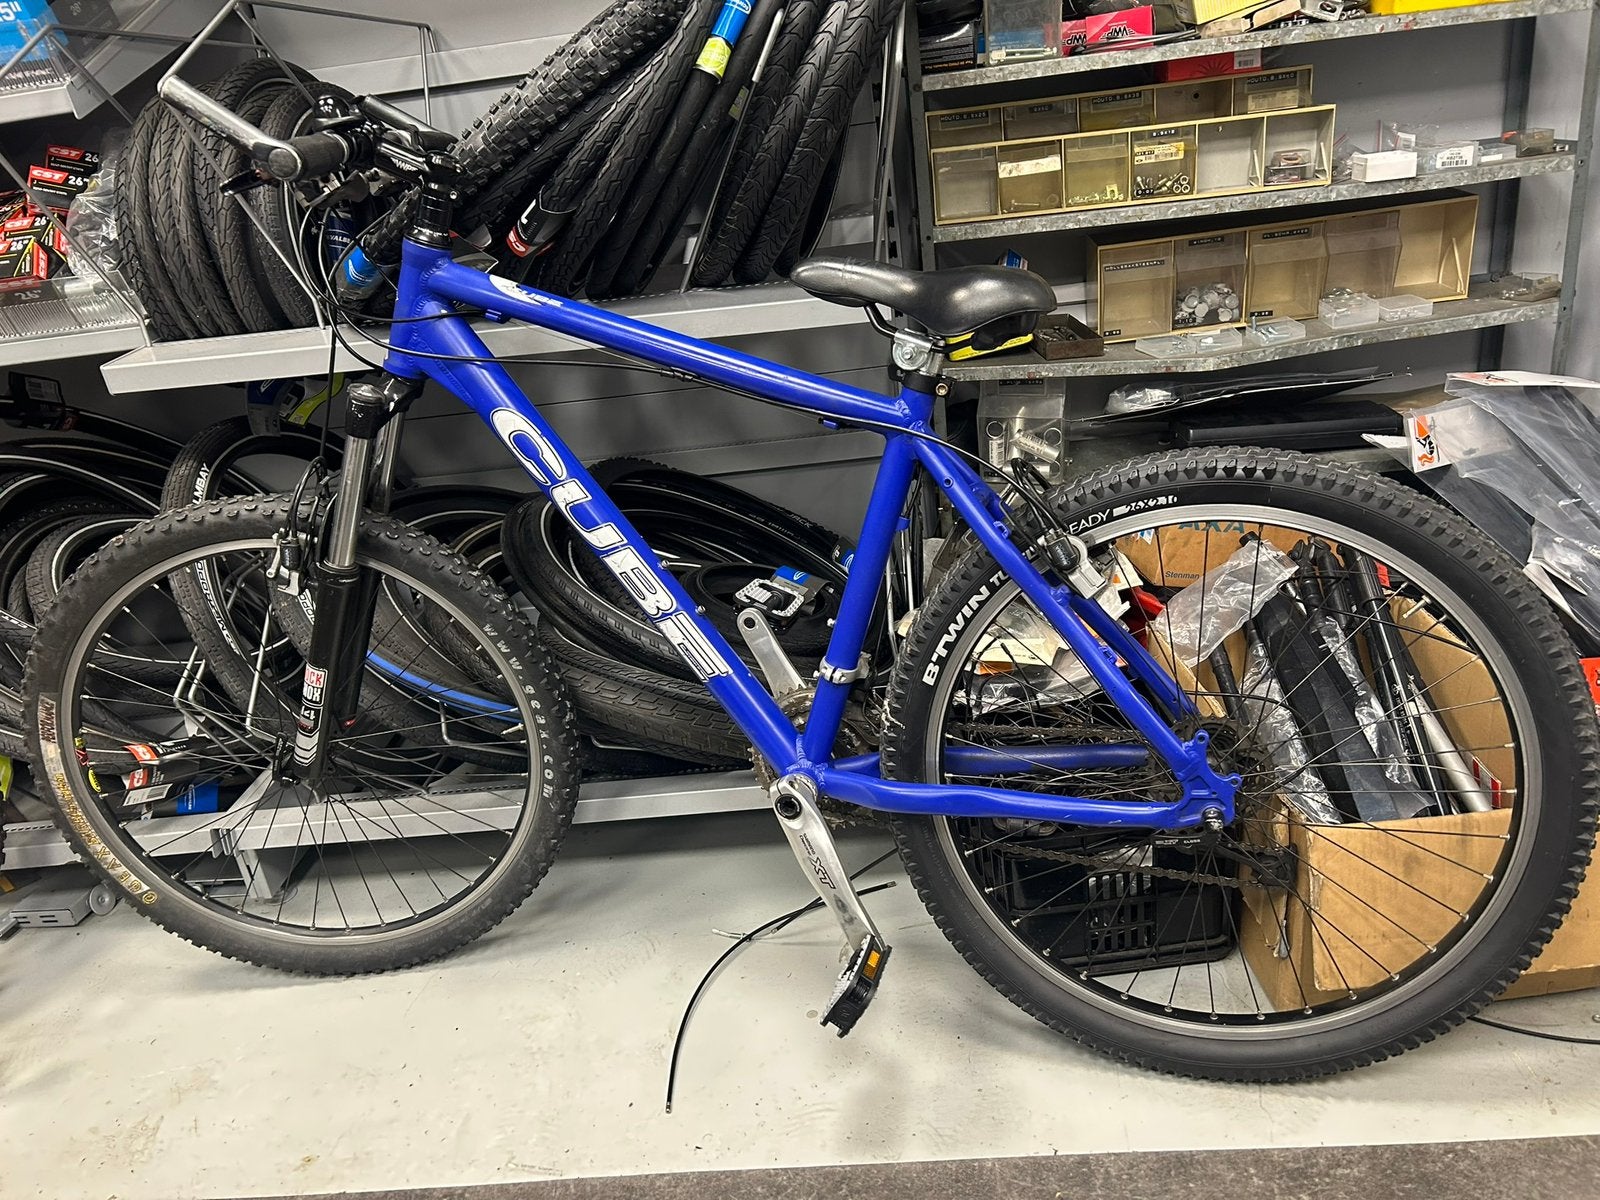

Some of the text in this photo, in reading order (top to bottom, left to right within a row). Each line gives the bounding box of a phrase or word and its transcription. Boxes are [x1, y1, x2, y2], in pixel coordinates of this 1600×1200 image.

[49, 146, 80, 157] CST
[31, 169, 64, 181] CST
[192, 463, 211, 505] LMBAY
[1069, 508, 1111, 535] EADY
[490, 408, 733, 682] CUBE
[1165, 570, 1200, 581] Stenman
[810, 856, 836, 889] XT
